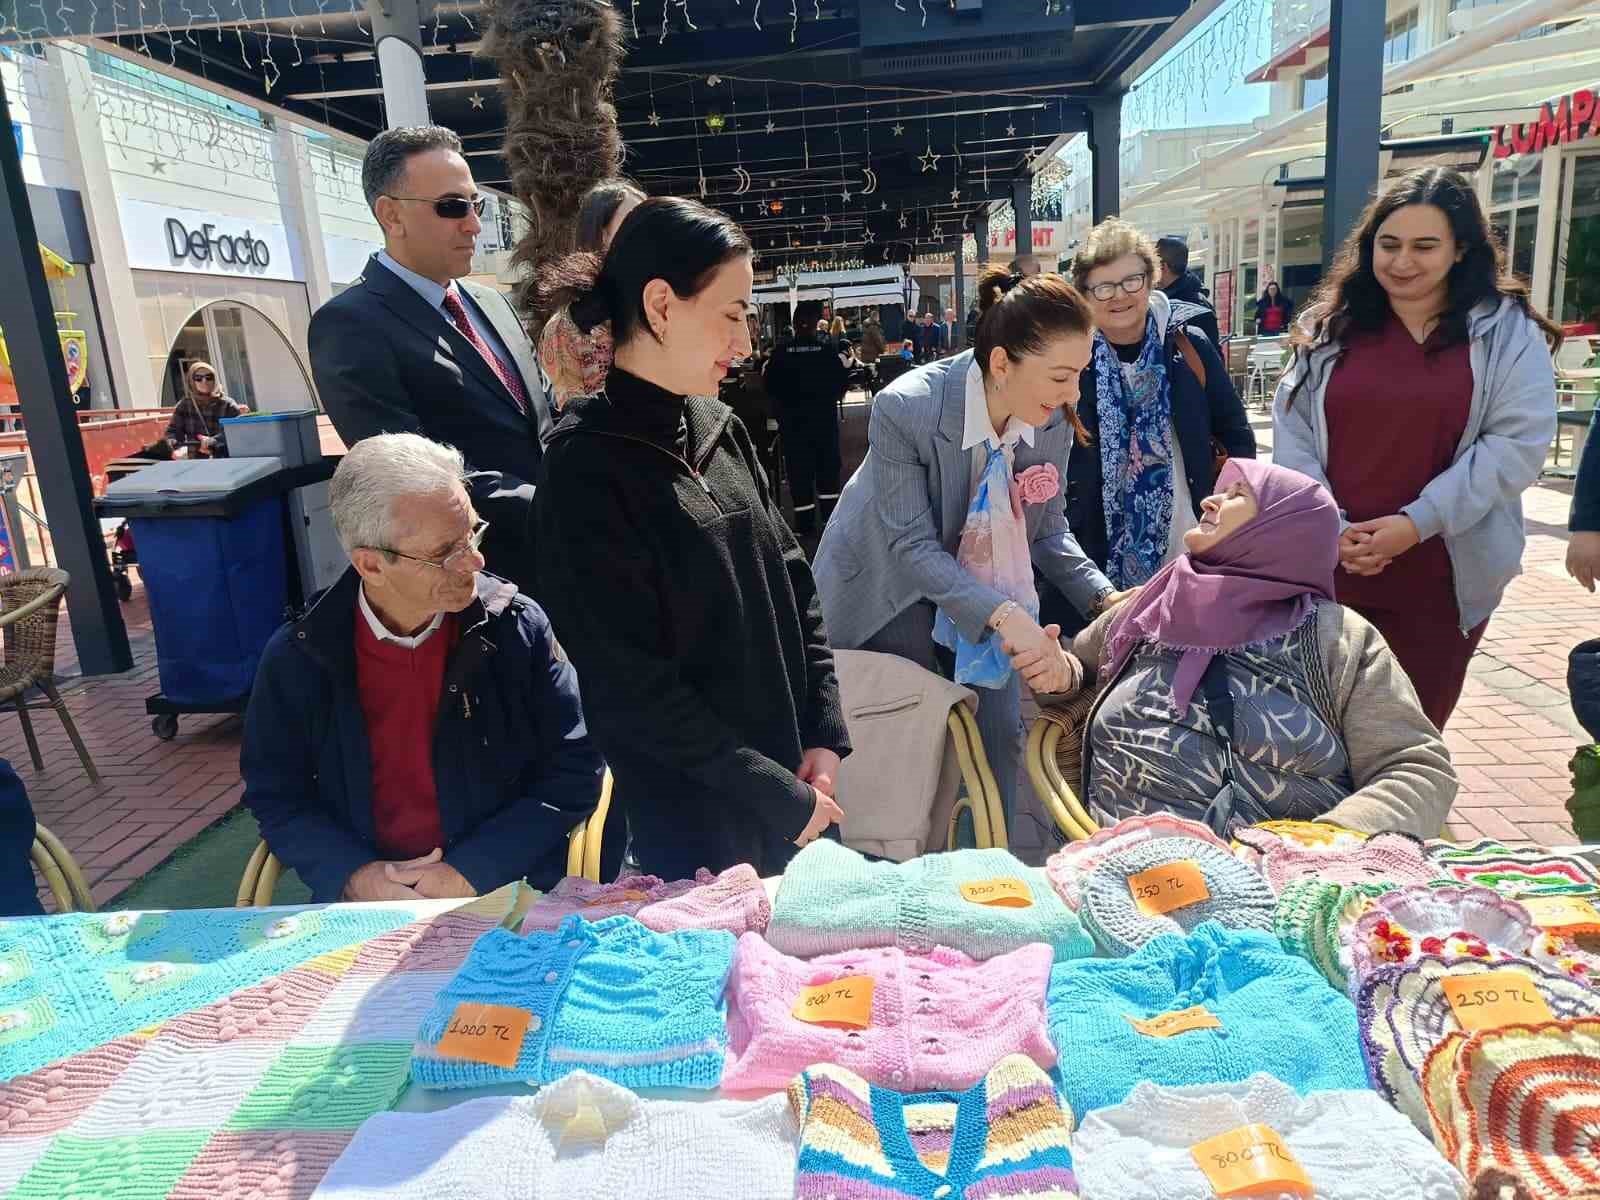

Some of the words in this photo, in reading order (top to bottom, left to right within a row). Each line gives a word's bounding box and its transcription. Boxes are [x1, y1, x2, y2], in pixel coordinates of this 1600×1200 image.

[165, 217, 270, 267] DeFacto
[1136, 884, 1160, 899] 250
[1166, 877, 1185, 890] TL
[835, 988, 855, 999] TL
[1456, 989, 1500, 1008] 250
[1504, 989, 1535, 1004] TL
[448, 1016, 487, 1037] 1000
[492, 1024, 511, 1041] TL
[1210, 1147, 1254, 1169] 800
[1259, 1141, 1293, 1162] TL
